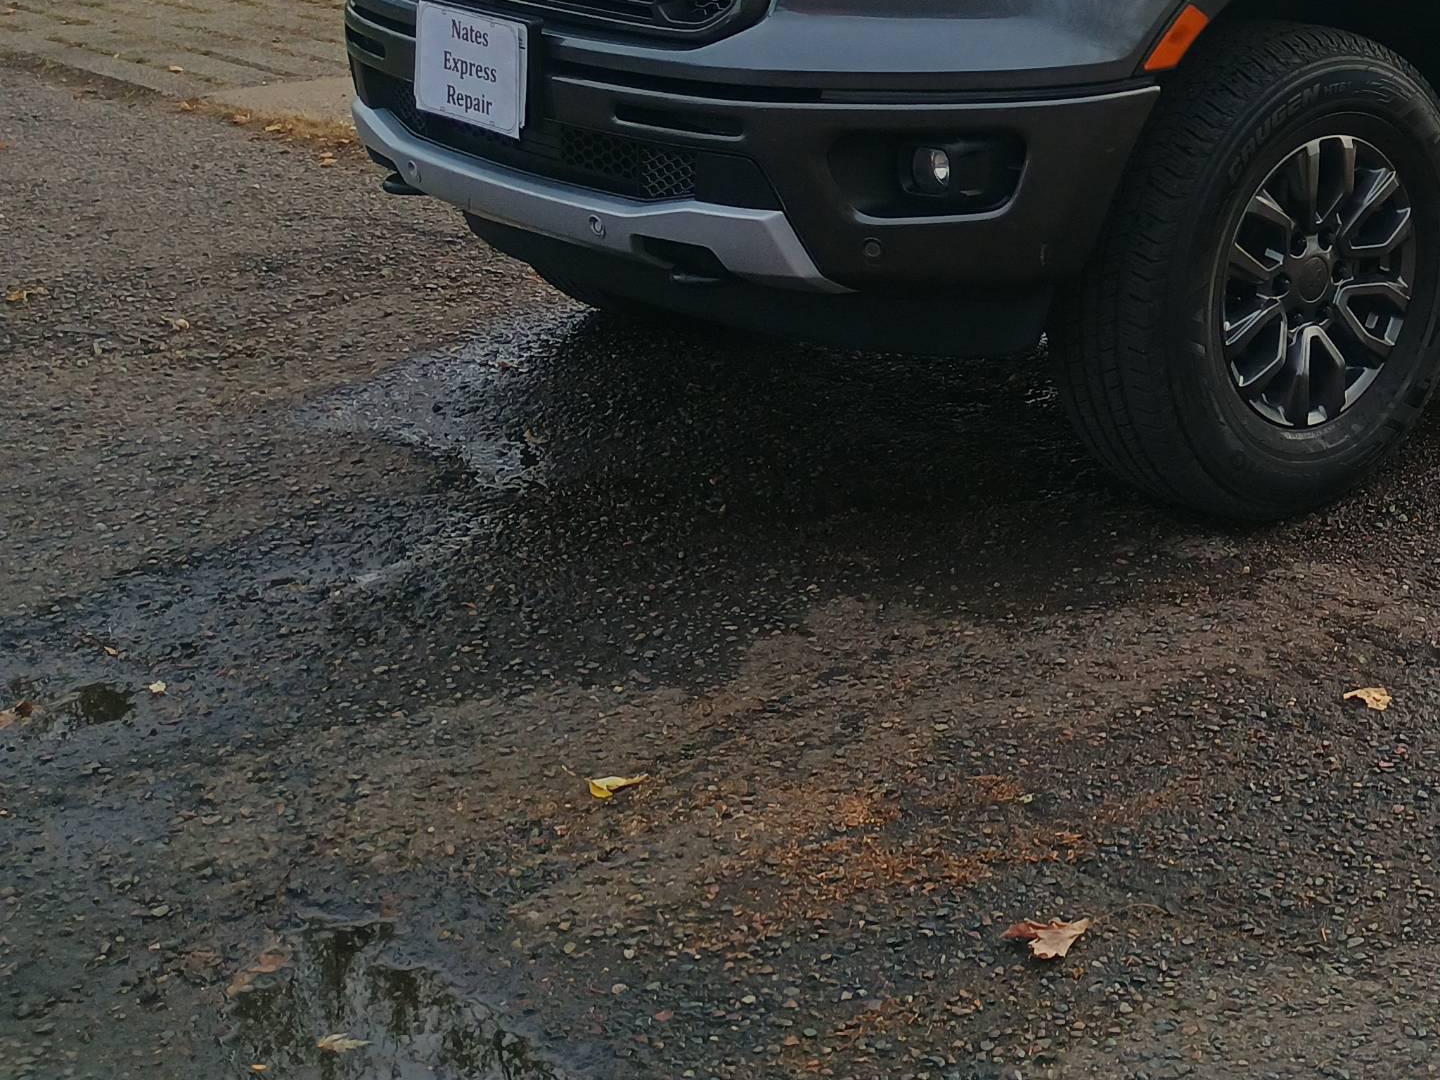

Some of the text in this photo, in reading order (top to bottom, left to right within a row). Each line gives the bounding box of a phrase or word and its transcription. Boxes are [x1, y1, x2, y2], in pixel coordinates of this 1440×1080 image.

[451, 19, 489, 47] Nates
[443, 50, 497, 83] Express
[446, 84, 493, 116] Repair
